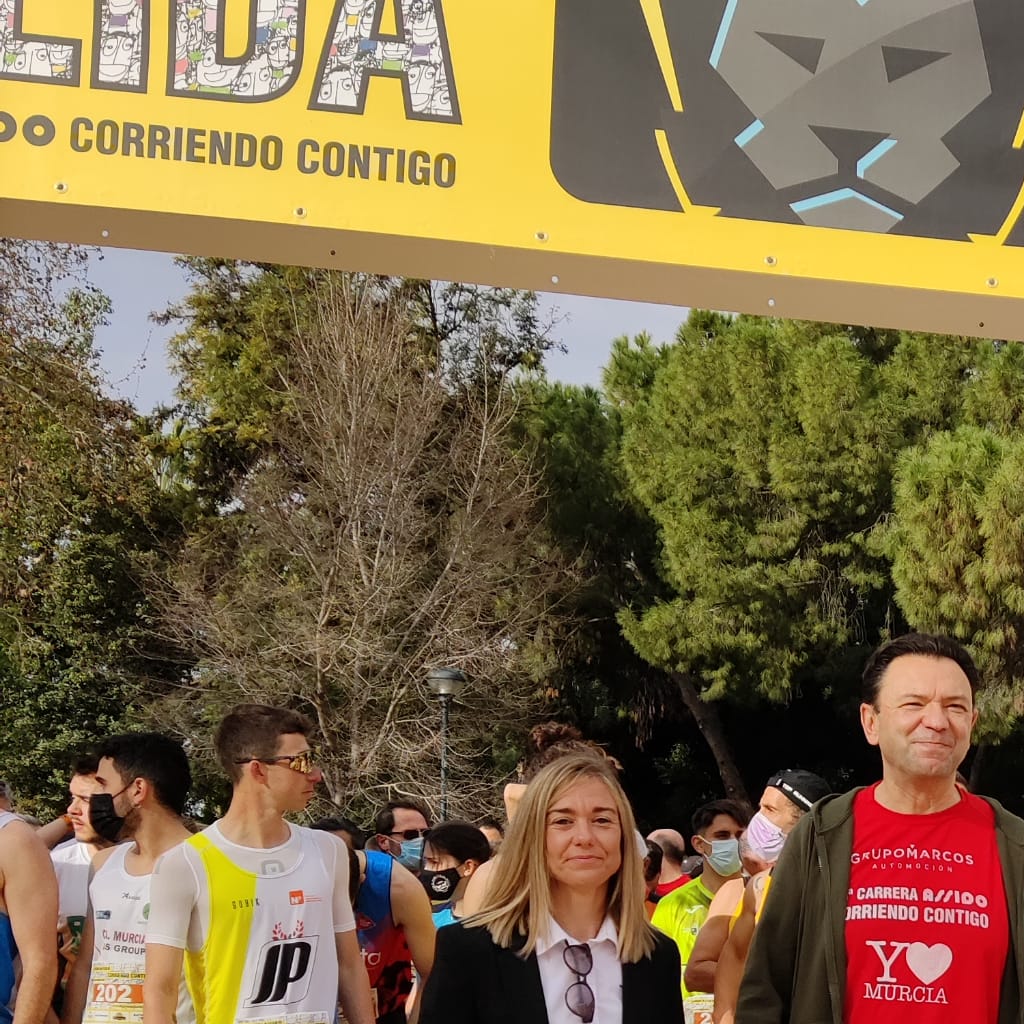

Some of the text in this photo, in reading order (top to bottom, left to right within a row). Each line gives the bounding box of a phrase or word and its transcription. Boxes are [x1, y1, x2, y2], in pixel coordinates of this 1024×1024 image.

[70, 116, 283, 171] CORRIENDO
[297, 138, 456, 189] CONTIGO
[856, 886, 919, 902] CARRERA
[922, 887, 989, 909] ASSIDO
[923, 906, 990, 929] CONTIGO
[114, 944, 146, 956] GROUP
[865, 940, 911, 983] Y
[95, 983, 133, 1003] 202
[863, 982, 949, 1005] MURCIA
